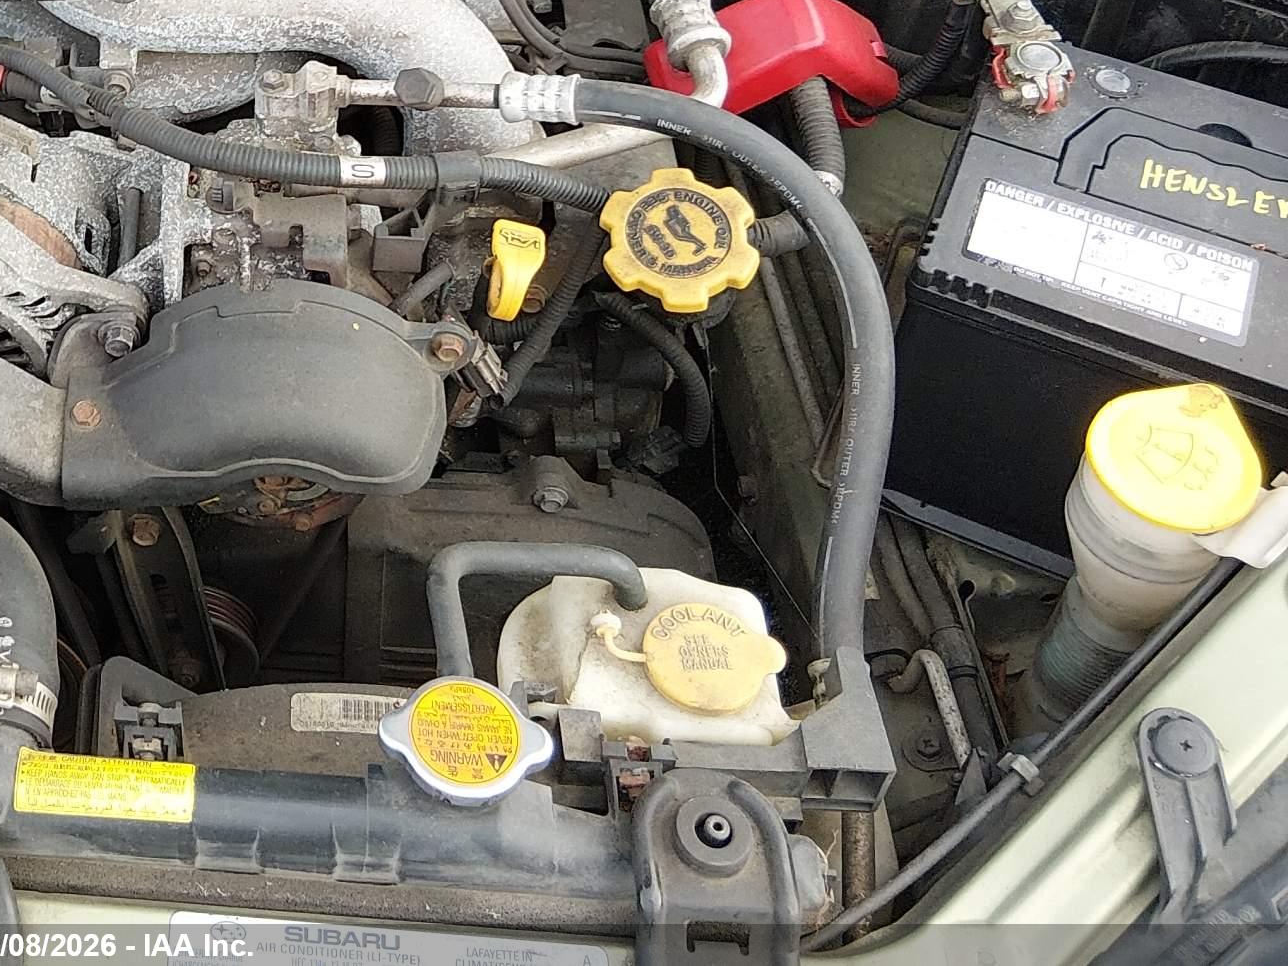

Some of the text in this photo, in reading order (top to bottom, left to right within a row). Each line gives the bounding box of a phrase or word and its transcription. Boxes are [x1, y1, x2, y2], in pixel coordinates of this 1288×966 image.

[351, 163, 375, 178] S
[673, 190, 729, 250] ENGINE OIL
[985, 180, 1044, 208] DANGER
[1057, 202, 1136, 236] EXPLOSIVE
[1149, 231, 1183, 251] ACID
[1197, 245, 1253, 272] POISON
[850, 363, 862, 395] INNER
[839, 438, 854, 477] OUTER
[651, 606, 745, 641] COOLANT
[683, 634, 710, 645] SEE
[681, 658, 733, 671] MANUAL
[431, 699, 496, 714] AVERTISSEMENT
[418, 728, 433, 738] HOT
[437, 729, 464, 741] WHEN
[487, 734, 513, 745] NEVER
[101, 757, 152, 768] ATTENTION
[430, 749, 484, 767] WARNING
[284, 925, 401, 951] SUBARU
[256, 941, 277, 953] AIR
[280, 943, 363, 961] CONDITIONER
[466, 947, 520, 961] LAFAYETTE
